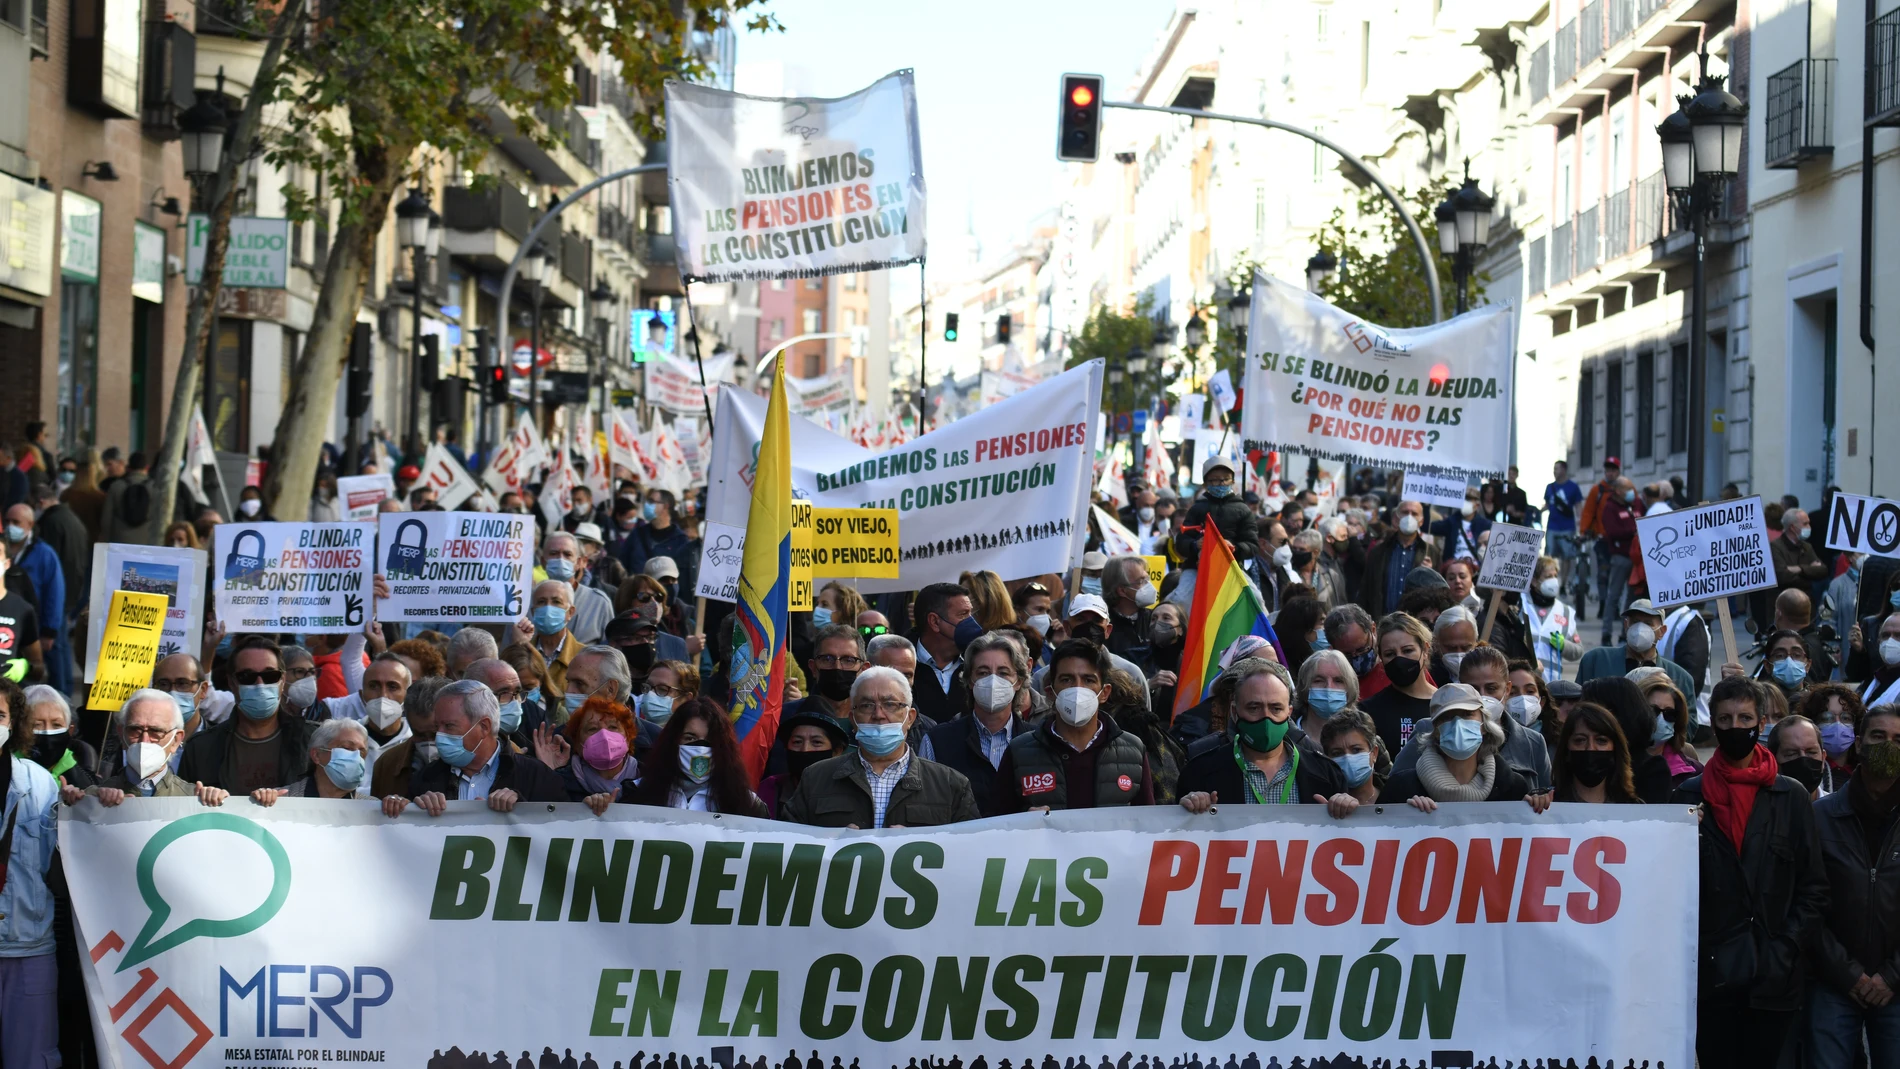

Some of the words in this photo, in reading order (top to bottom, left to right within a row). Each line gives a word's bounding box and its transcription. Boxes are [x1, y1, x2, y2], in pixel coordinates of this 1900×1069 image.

[741, 148, 875, 195] BLINDEMOS
[705, 207, 737, 232] LAS
[742, 183, 872, 230] PENSIONES
[876, 181, 903, 207] EN
[701, 243, 723, 266] LA
[725, 206, 908, 264] CONSTITUCIÓN
[1282, 355, 1306, 375] SE
[1309, 360, 1389, 393] BLINDÓ
[1394, 377, 1418, 396] LA
[1291, 382, 1343, 411] ¿POR
[1347, 398, 1387, 420] QUÉ
[1390, 403, 1421, 423] NO
[1425, 406, 1462, 426] LAS
[1307, 413, 1440, 452] PENSIONES?
[816, 448, 937, 492] BLINDEMOS
[943, 449, 969, 468] LAS
[975, 422, 1086, 462] PENSIONES
[900, 462, 1056, 512] CONSTITUCIÓN
[1404, 483, 1409, 494] y
[1410, 484, 1418, 493] no
[1424, 482, 1432, 495] los
[1433, 484, 1464, 499] Borbones!
[460, 519, 523, 539] BLINDAR
[816, 518, 843, 535] SOY
[847, 517, 891, 537] VIEJO,
[1684, 503, 1754, 537] ¡¡UNIDAD!!
[1829, 496, 1900, 553] NO
[299, 528, 362, 548] BLINDAR
[1710, 533, 1760, 558] BLINDAR
[280, 549, 362, 569] PENSIONES
[397, 546, 421, 558] MERP
[441, 539, 524, 560] PENSIONES
[811, 548, 828, 565] NO
[832, 548, 897, 564] PENDEJO.
[1510, 551, 1535, 566] BLINDAR
[1670, 545, 1697, 560] MERP
[235, 556, 259, 568] MERP
[386, 568, 399, 581] EN
[419, 561, 523, 582] CONSTITUCIÓN
[1502, 562, 1532, 578] PENSIONES
[1685, 570, 1697, 580] LAS
[1699, 550, 1763, 577] PENSIONES
[258, 571, 362, 592] CONSTITUCIÓN
[393, 585, 430, 595] RECORTES
[438, 585, 491, 595] PRIVATIZACIÓN
[701, 584, 711, 594] EN
[710, 586, 719, 596] LA
[725, 576, 735, 584] LAS
[1491, 573, 1529, 590] CONSTITUCIÓN
[1658, 591, 1669, 603] EN
[1671, 589, 1681, 600] LA
[1684, 567, 1766, 598] CONSTITUCIÓN
[231, 596, 269, 605] RECORTES
[277, 596, 331, 606] PRIVATIZACIÓN
[791, 581, 812, 606] LEY!
[404, 608, 439, 616] RECORTES
[440, 605, 467, 616] CERO
[468, 606, 503, 616] TENERIFE
[242, 619, 278, 627] RECORTES
[280, 616, 307, 627] CERO
[308, 616, 344, 627] TENERIFE
[1023, 773, 1054, 789] USO
[429, 835, 944, 930] BLINDEMOS
[974, 856, 1108, 928] LAS
[1137, 835, 1627, 927] PENSIONES
[589, 968, 660, 1037] EN
[697, 968, 779, 1037] LA
[799, 936, 1466, 1042] CONSTITUCIÓN
[219, 964, 394, 1039] MERP
[224, 1048, 251, 1061] MESA
[254, 1048, 294, 1062] ESTATAL
[297, 1049, 319, 1062] POR
[322, 1050, 333, 1062] EL
[336, 1050, 385, 1062] BLINDAJE
